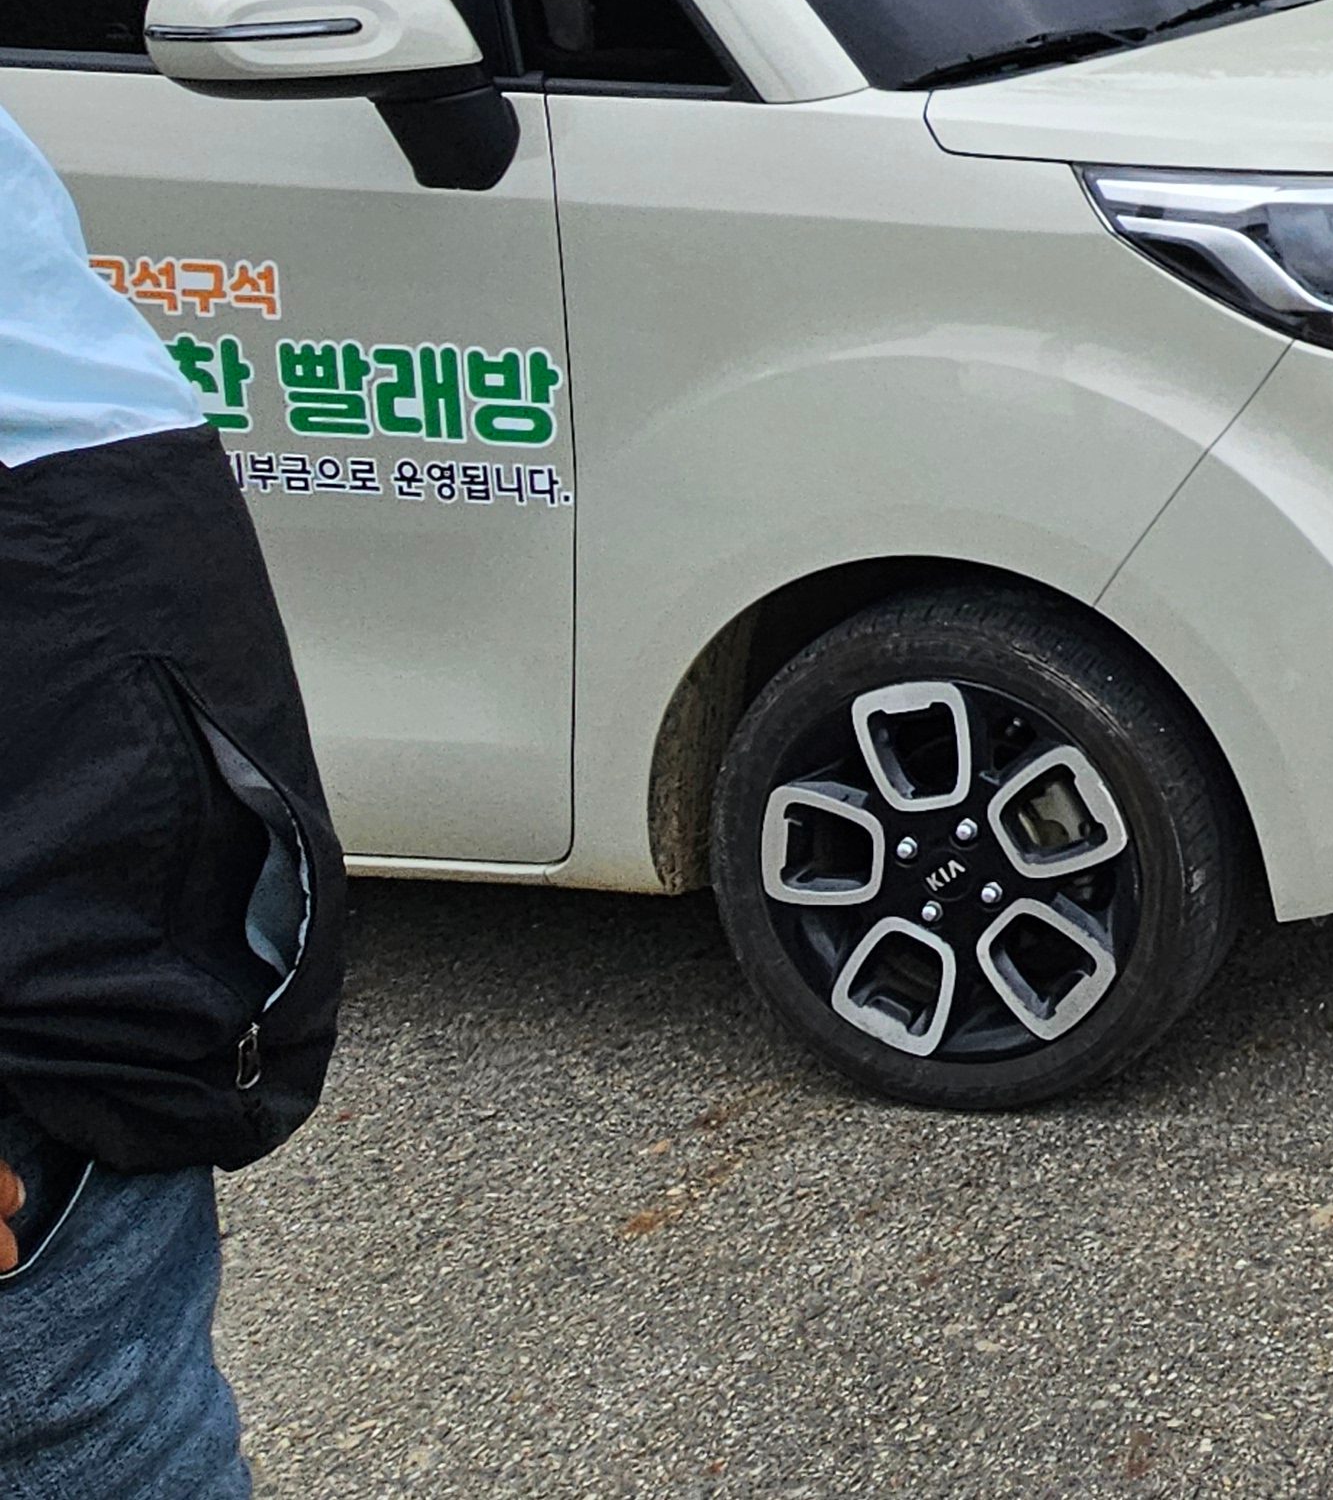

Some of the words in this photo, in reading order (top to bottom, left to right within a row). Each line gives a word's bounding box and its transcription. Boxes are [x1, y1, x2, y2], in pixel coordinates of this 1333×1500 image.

[279, 341, 560, 444] 빨래방
[393, 461, 571, 504] 운영됩니다.
[925, 860, 966, 891] KIA
